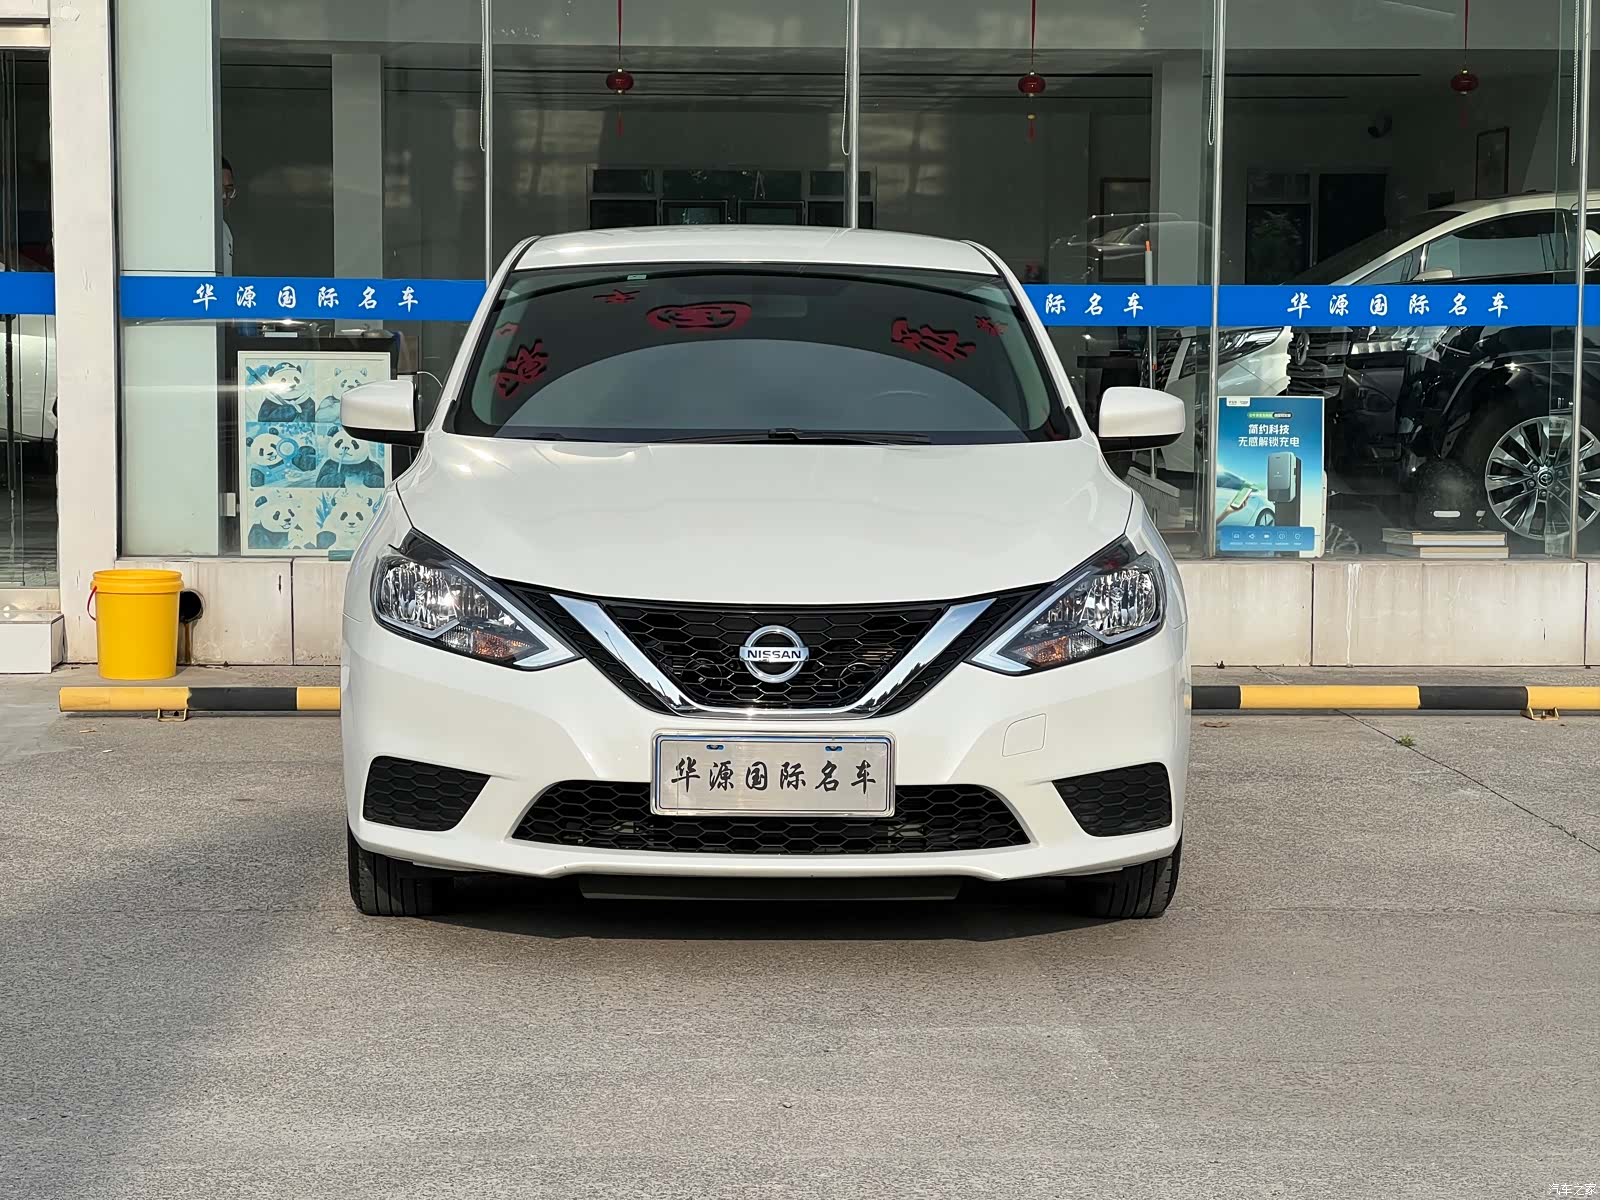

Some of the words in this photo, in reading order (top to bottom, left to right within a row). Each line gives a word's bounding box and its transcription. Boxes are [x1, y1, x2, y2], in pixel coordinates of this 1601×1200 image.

[193, 283, 419, 312] 华源国际名车
[1287, 292, 1509, 319] 华源国际名车
[1248, 424, 1290, 435] 简约科技
[1238, 436, 1300, 448] 无感解锁充电
[747, 649, 802, 660] NISSAN
[671, 756, 877, 795] 华源国际名车
